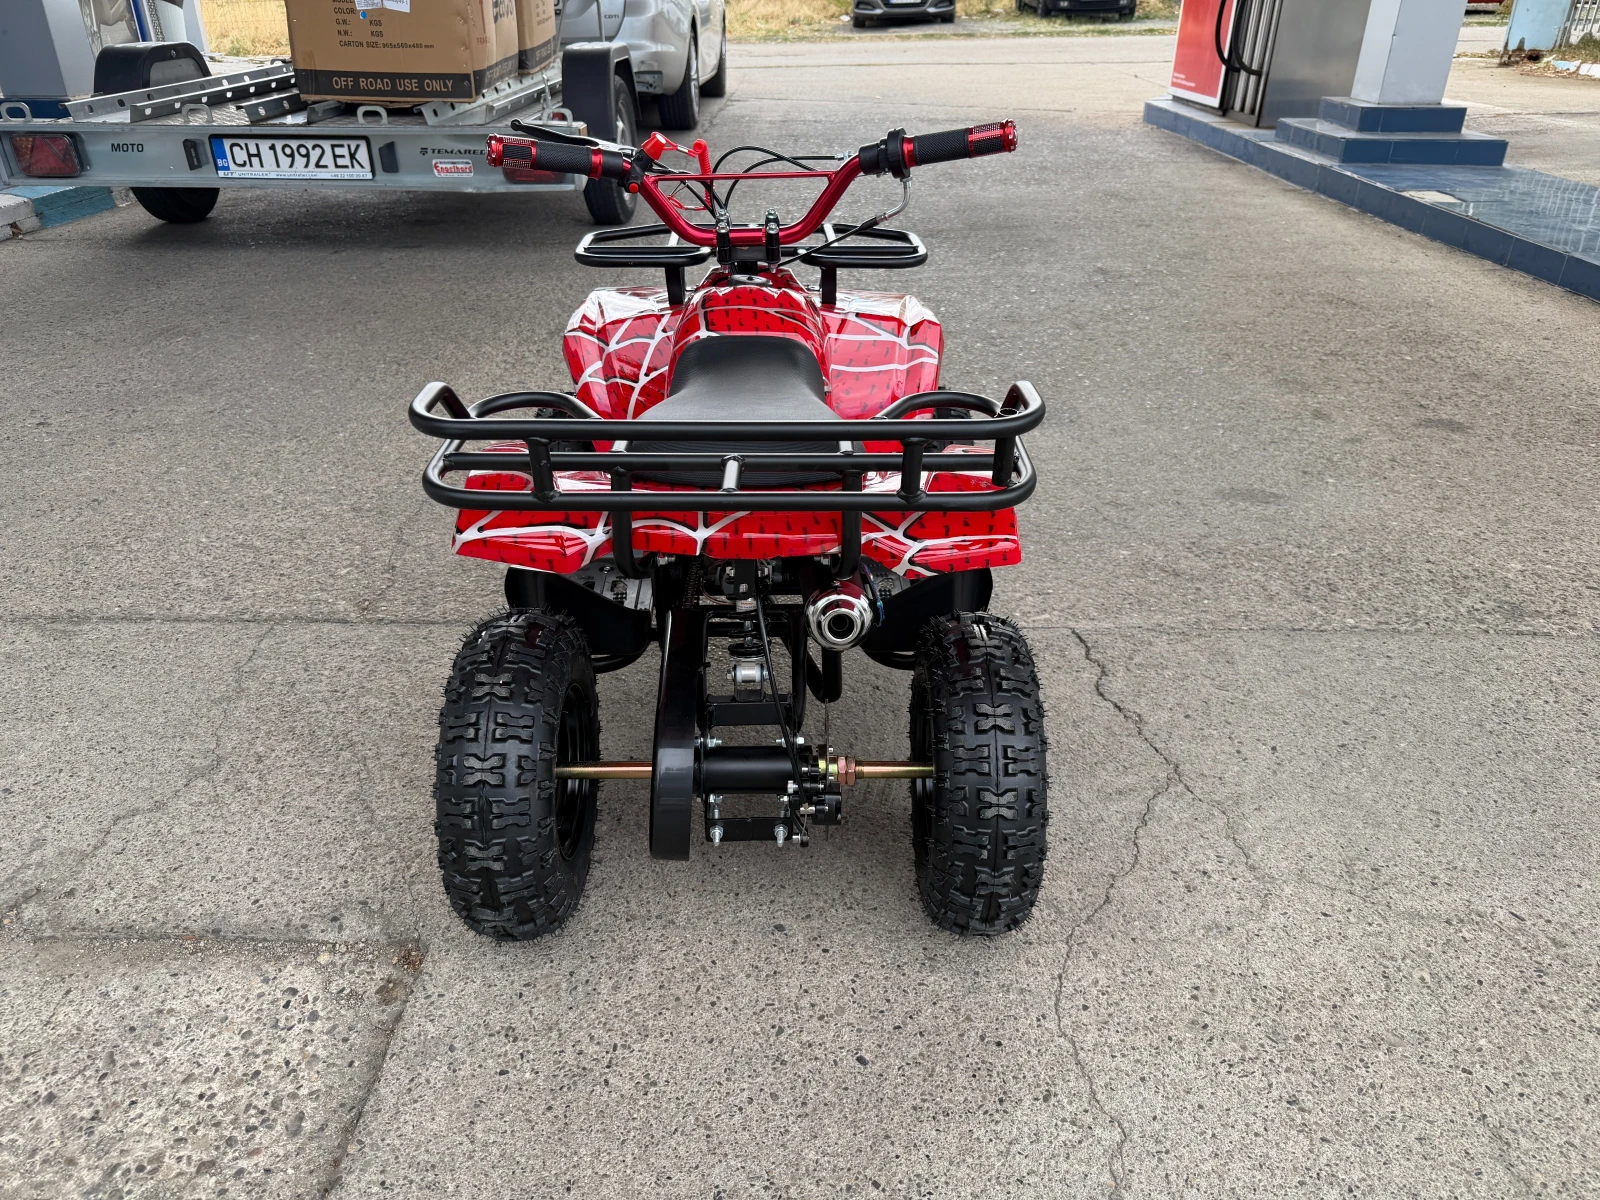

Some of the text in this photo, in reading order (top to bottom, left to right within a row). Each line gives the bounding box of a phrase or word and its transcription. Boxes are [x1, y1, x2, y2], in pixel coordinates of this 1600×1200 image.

[333, 7, 357, 15] COLOR:
[339, 40, 364, 48] CARTON
[366, 41, 381, 49] SIZE:
[332, 77, 453, 92] OFF ROAD USE ONLY
[111, 143, 144, 152] MOTO
[229, 142, 366, 169] CH 1992 EK
[217, 158, 228, 167] BG
